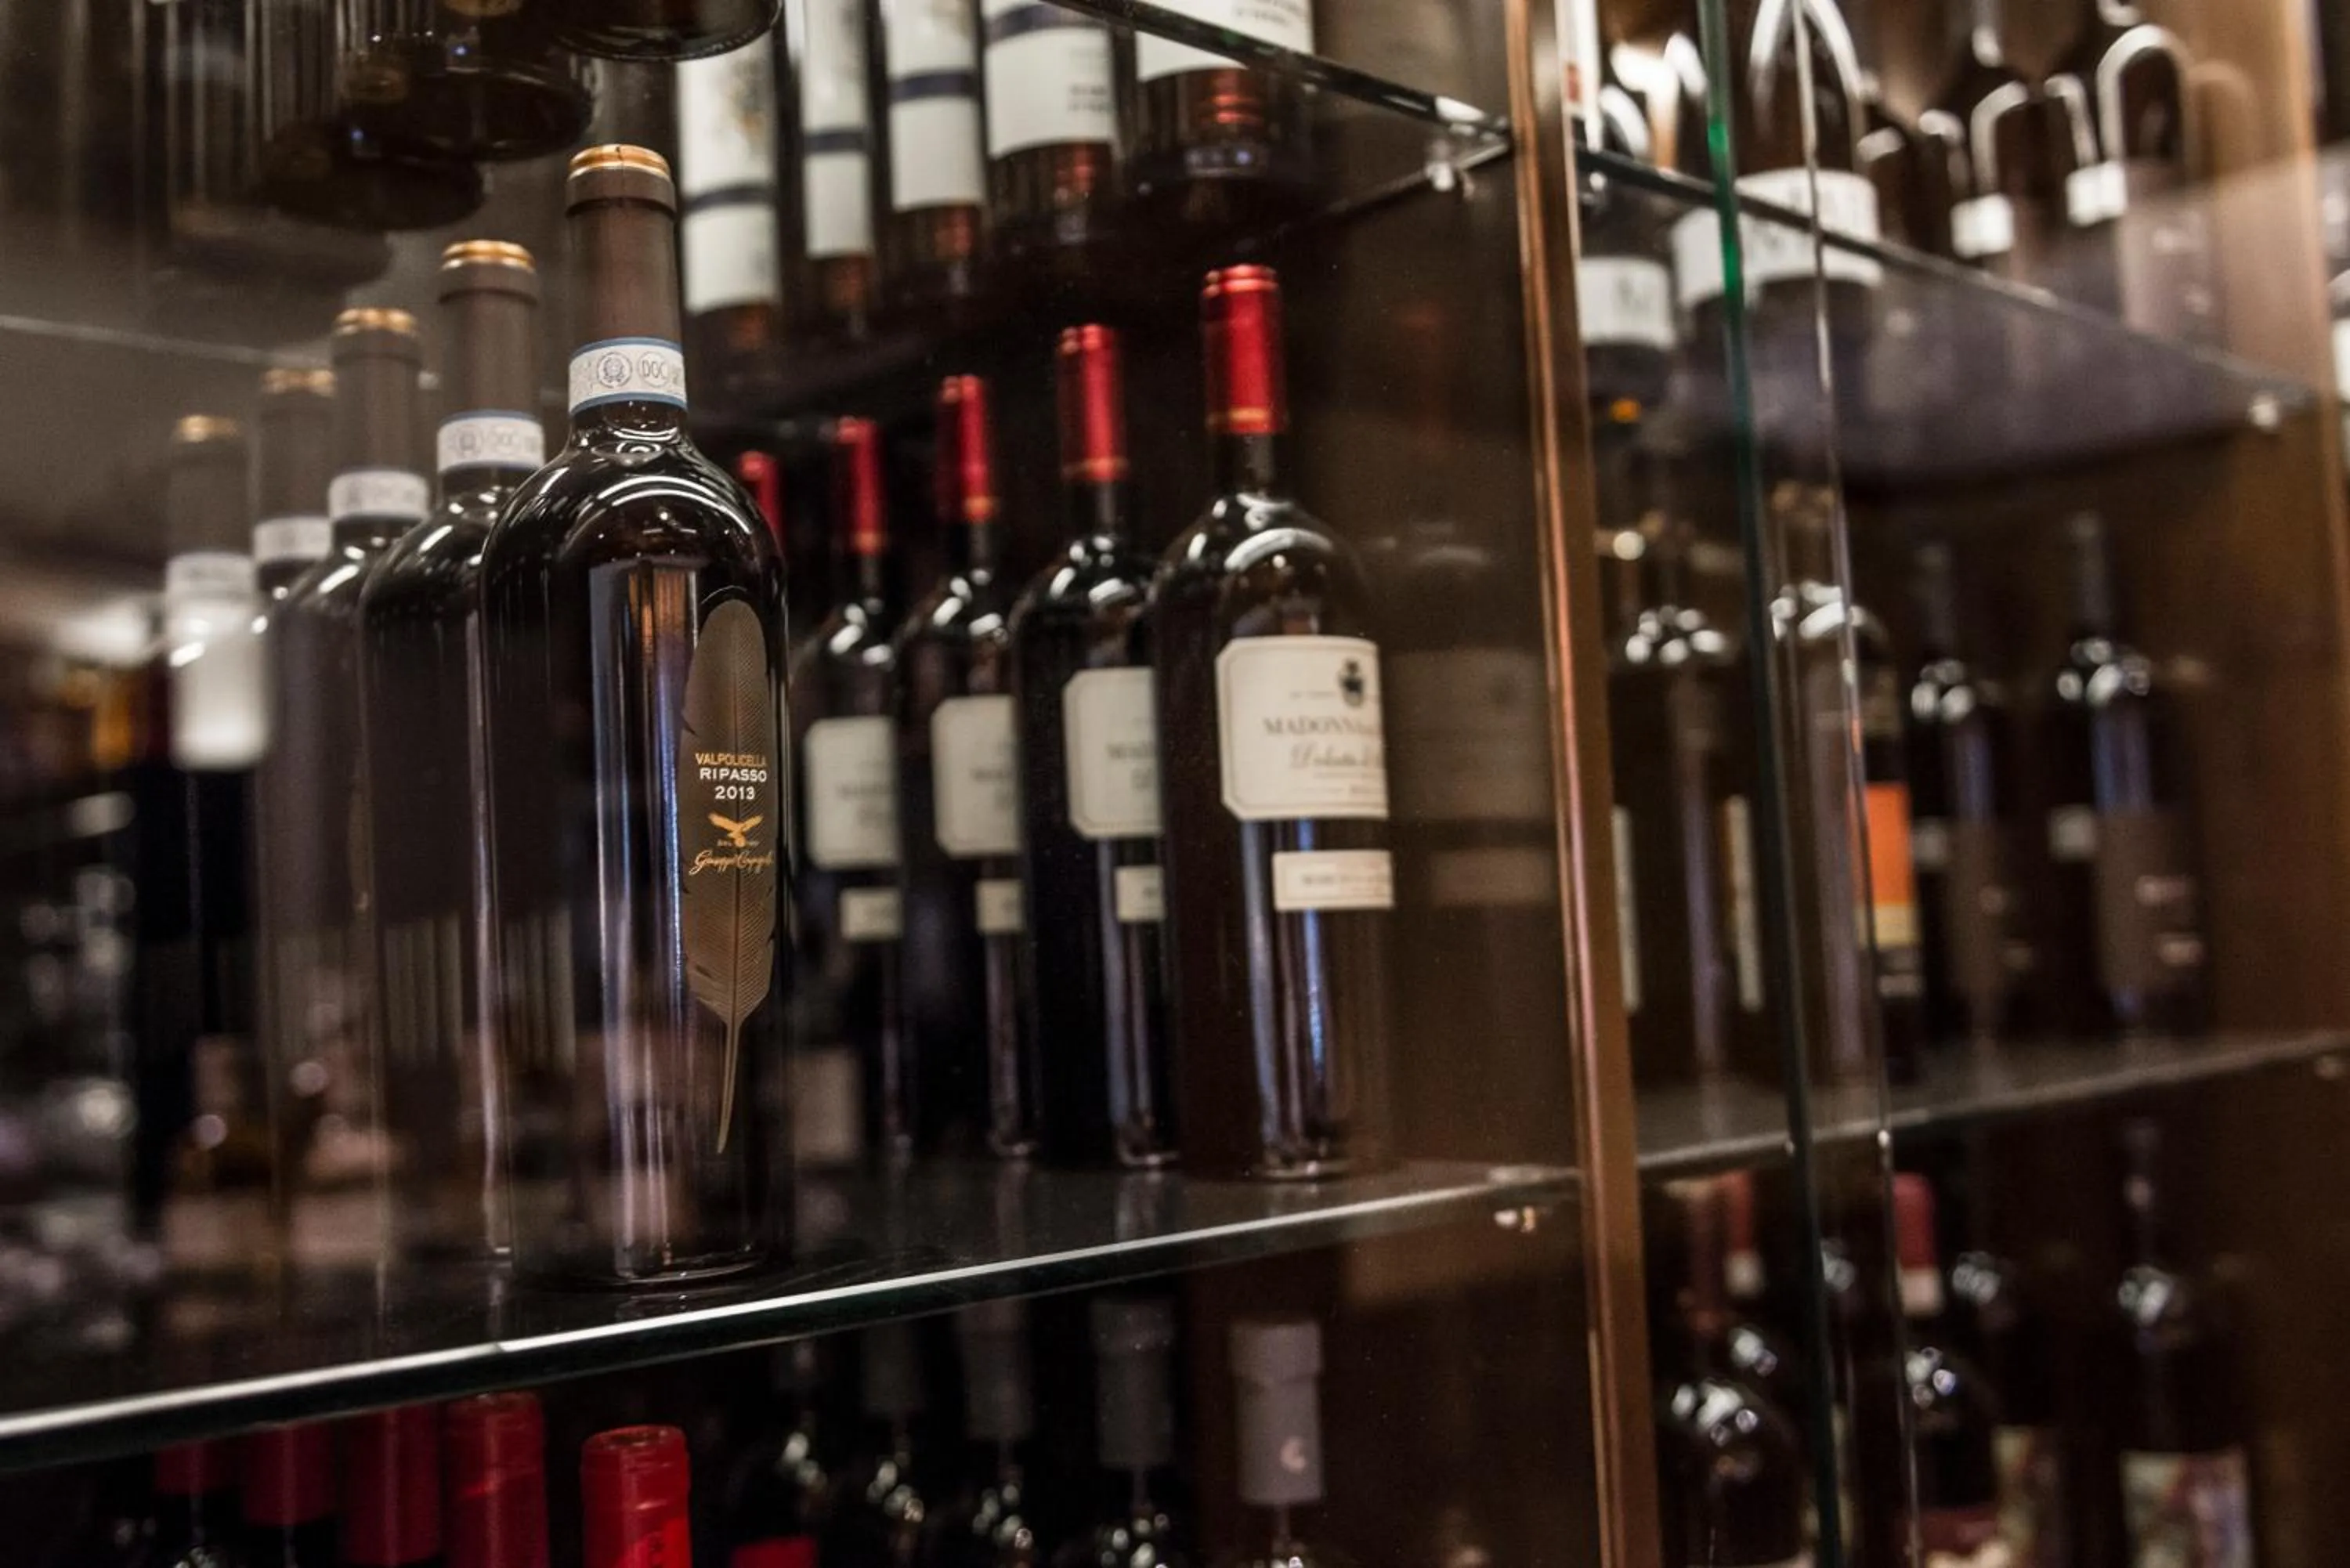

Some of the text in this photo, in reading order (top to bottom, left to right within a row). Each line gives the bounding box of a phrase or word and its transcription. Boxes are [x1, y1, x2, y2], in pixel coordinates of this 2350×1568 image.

[695, 753, 767, 767] VALPOLICELLA
[700, 768, 767, 782] RIPASSO
[714, 786, 756, 800] 2013
